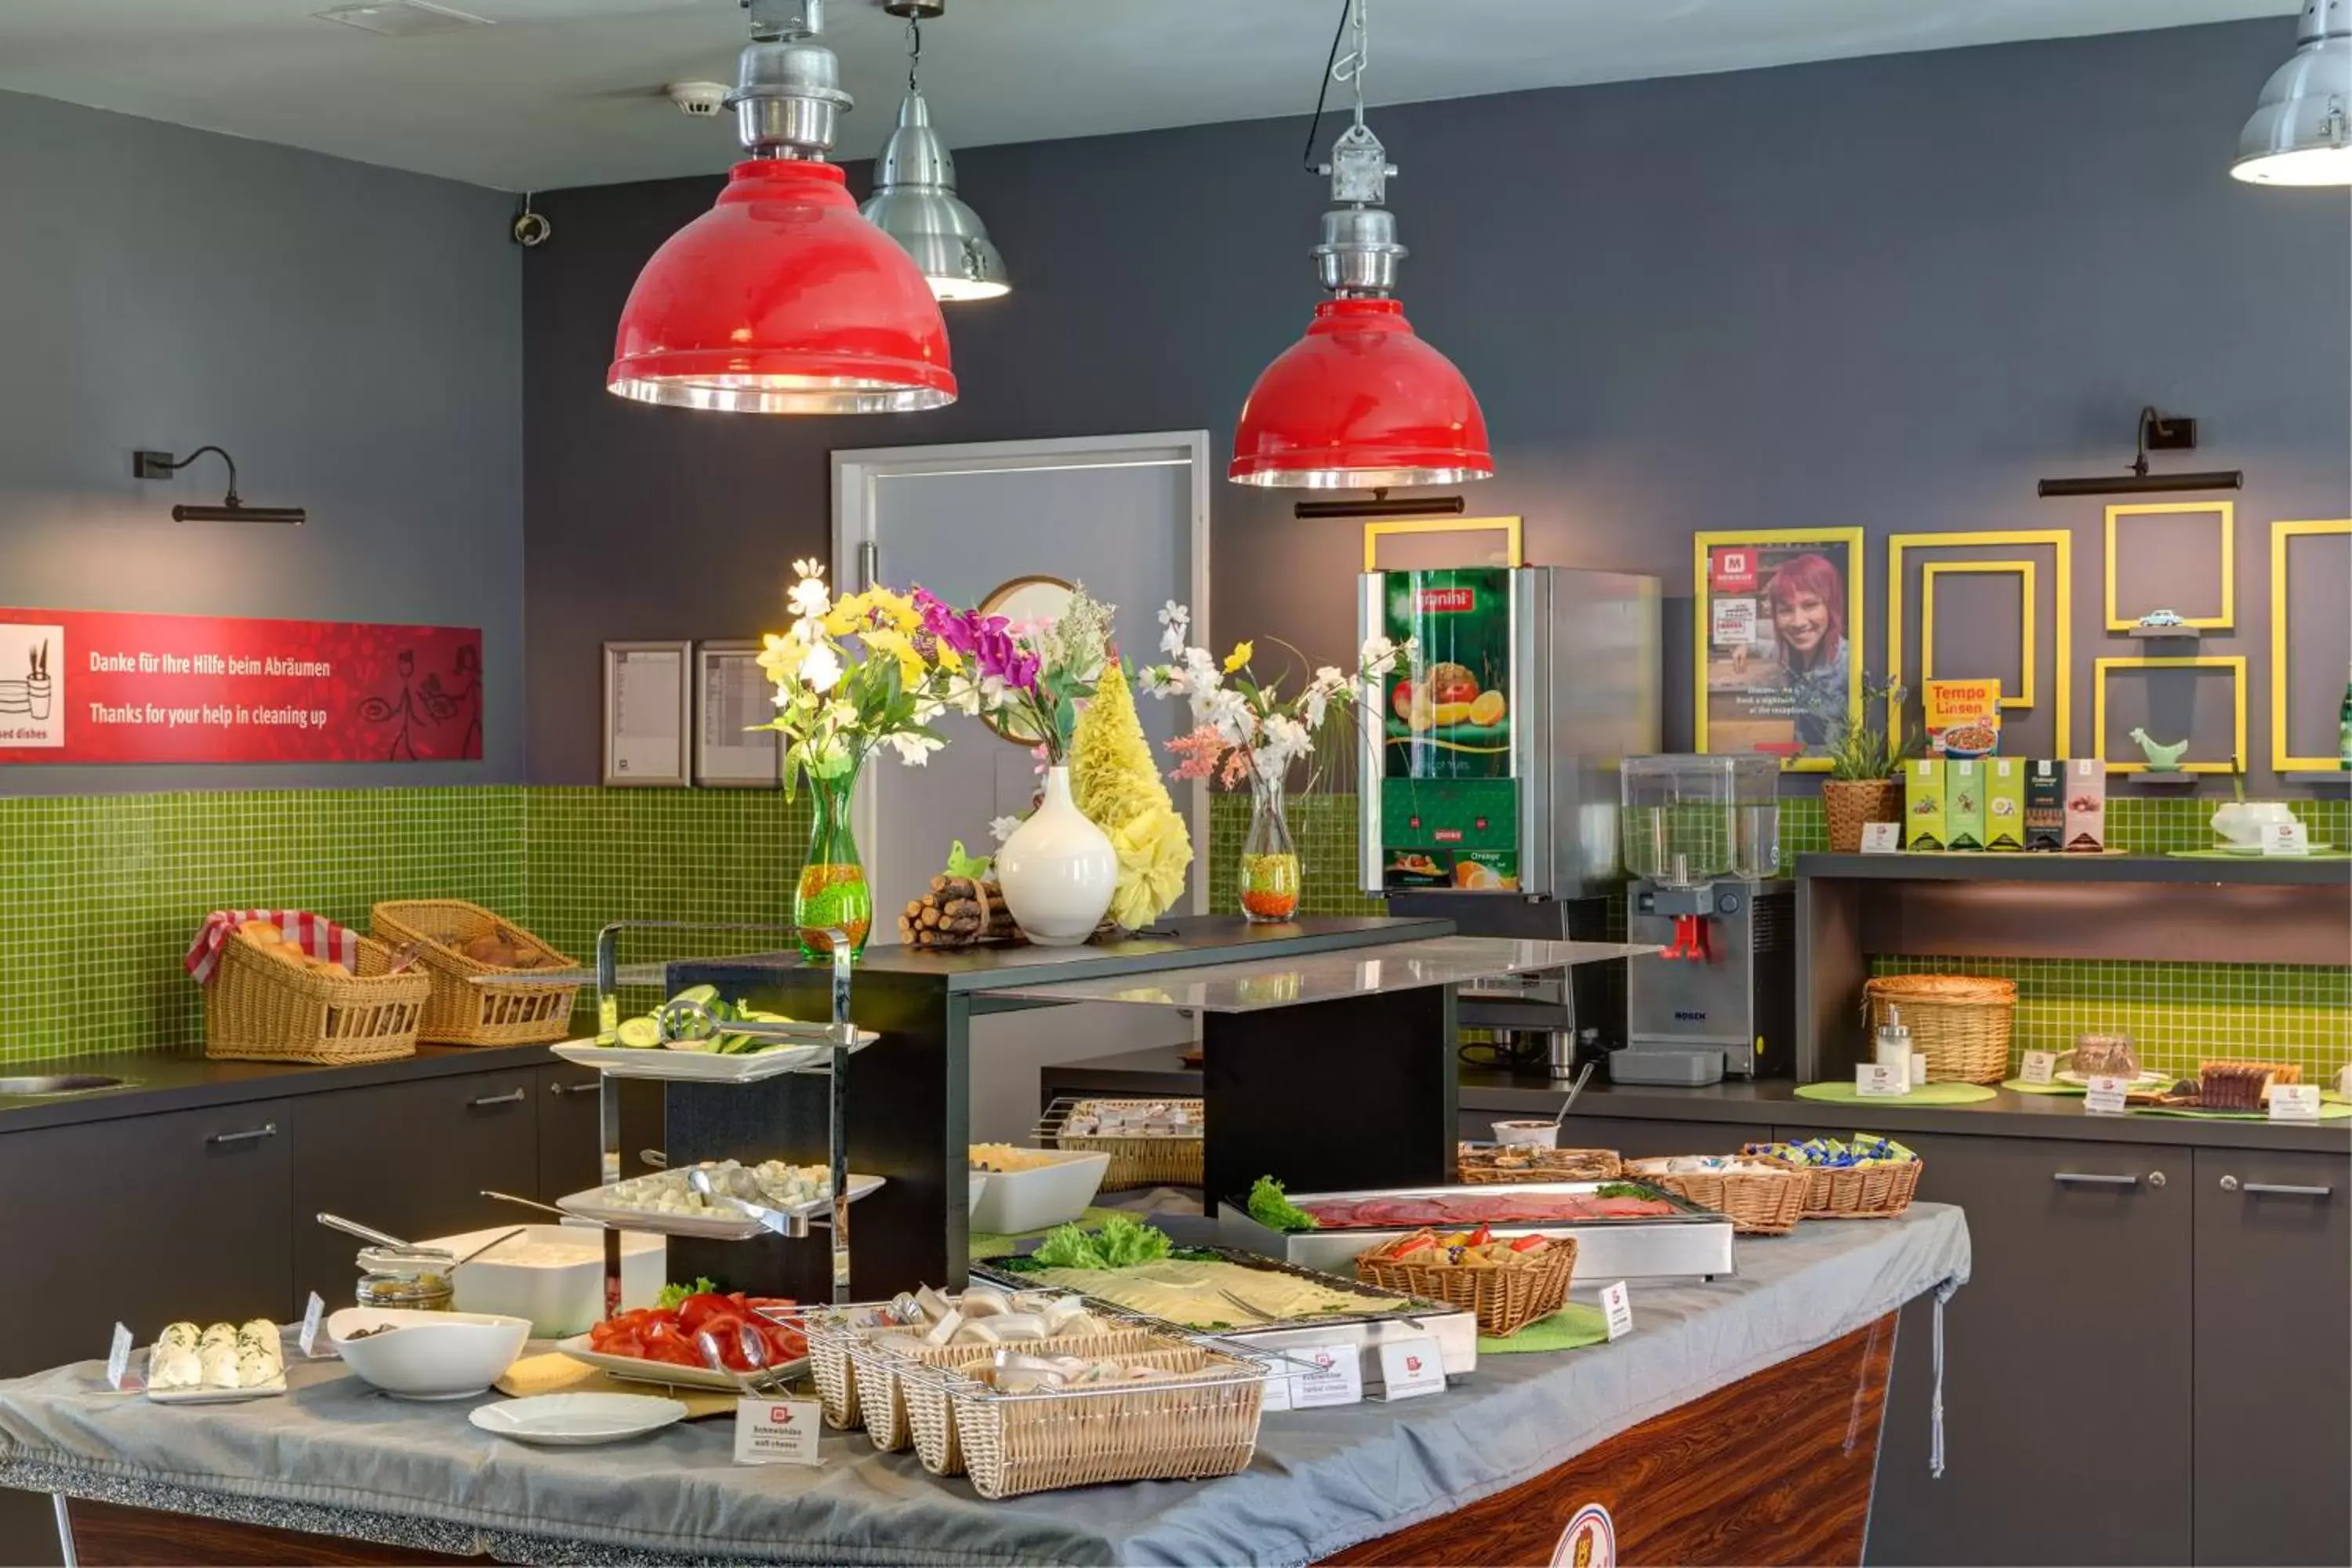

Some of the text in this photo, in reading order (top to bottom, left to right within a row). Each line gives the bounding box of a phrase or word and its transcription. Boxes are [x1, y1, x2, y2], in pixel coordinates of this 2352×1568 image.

[89, 652, 331, 677] Danke für Ihre Hilfe beim Abräumen
[1933, 686, 1985, 700] Tempo
[89, 702, 327, 728] Thanks for your help in cleaning up
[1936, 702, 1983, 714] Linsen
[16, 728, 47, 740] dishes
